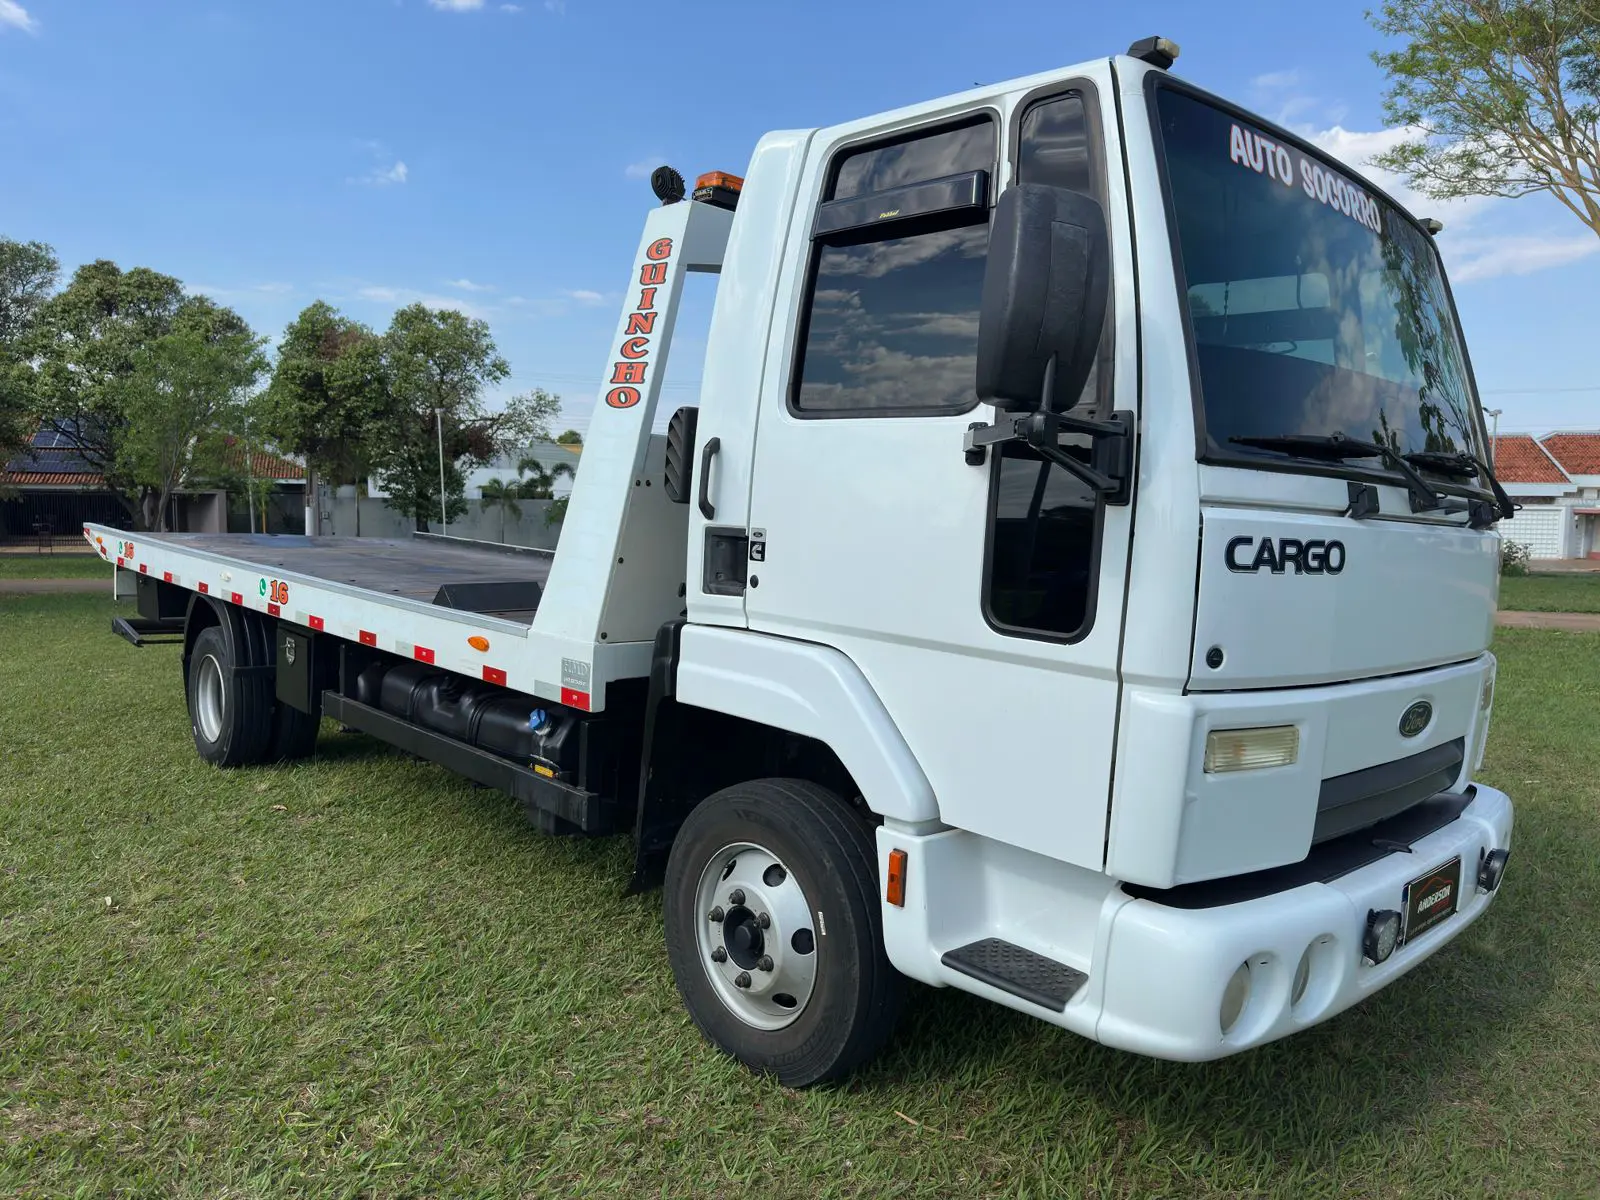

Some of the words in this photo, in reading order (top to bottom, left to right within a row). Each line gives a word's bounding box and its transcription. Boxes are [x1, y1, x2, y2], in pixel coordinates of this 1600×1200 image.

[1230, 123, 1293, 187] AUTO
[1300, 158, 1382, 235] SOCORRO
[605, 237, 673, 409] GUINCHO
[270, 579, 289, 605] 16
[1224, 535, 1346, 575] CARGO
